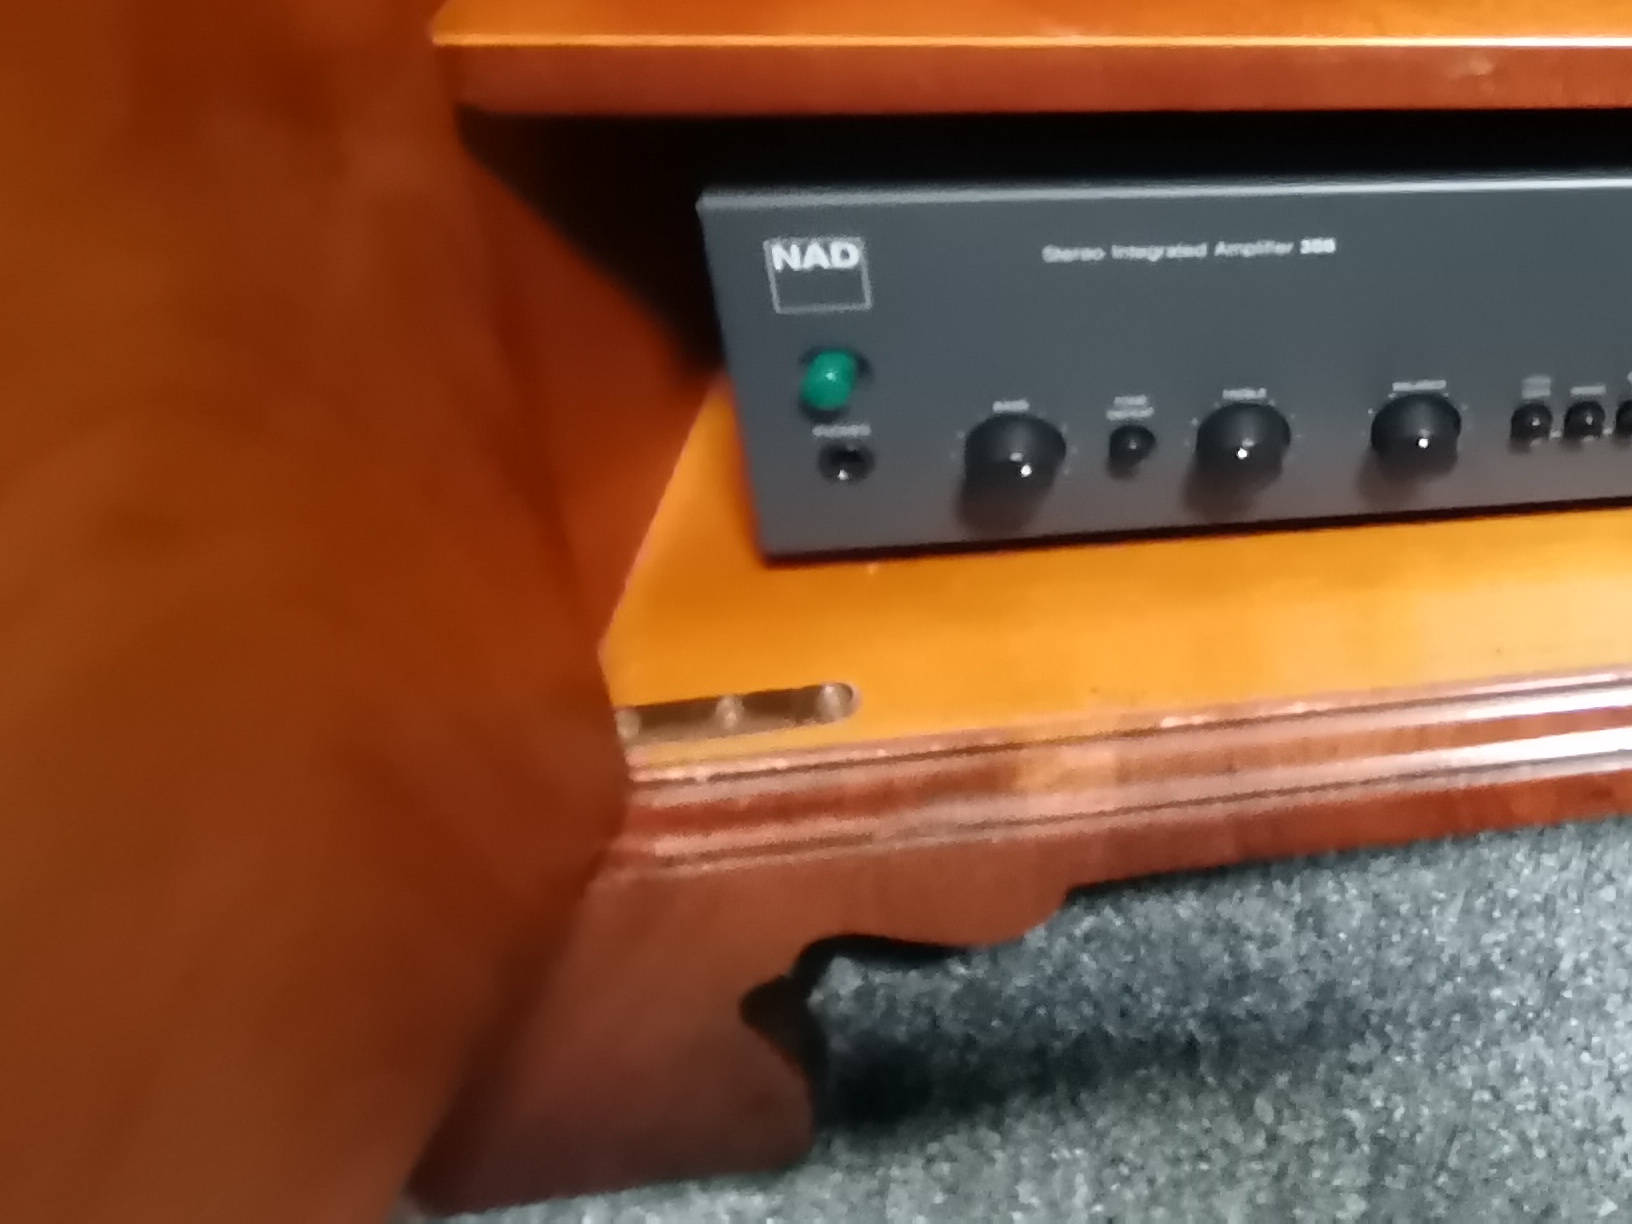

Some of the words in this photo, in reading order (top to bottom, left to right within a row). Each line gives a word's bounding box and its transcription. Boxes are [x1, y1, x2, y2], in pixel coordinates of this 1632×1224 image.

[771, 240, 861, 271] NAD
[1042, 244, 1106, 263] Stereo
[1111, 243, 1208, 262] Integrated
[1214, 239, 1294, 258] Amplifier
